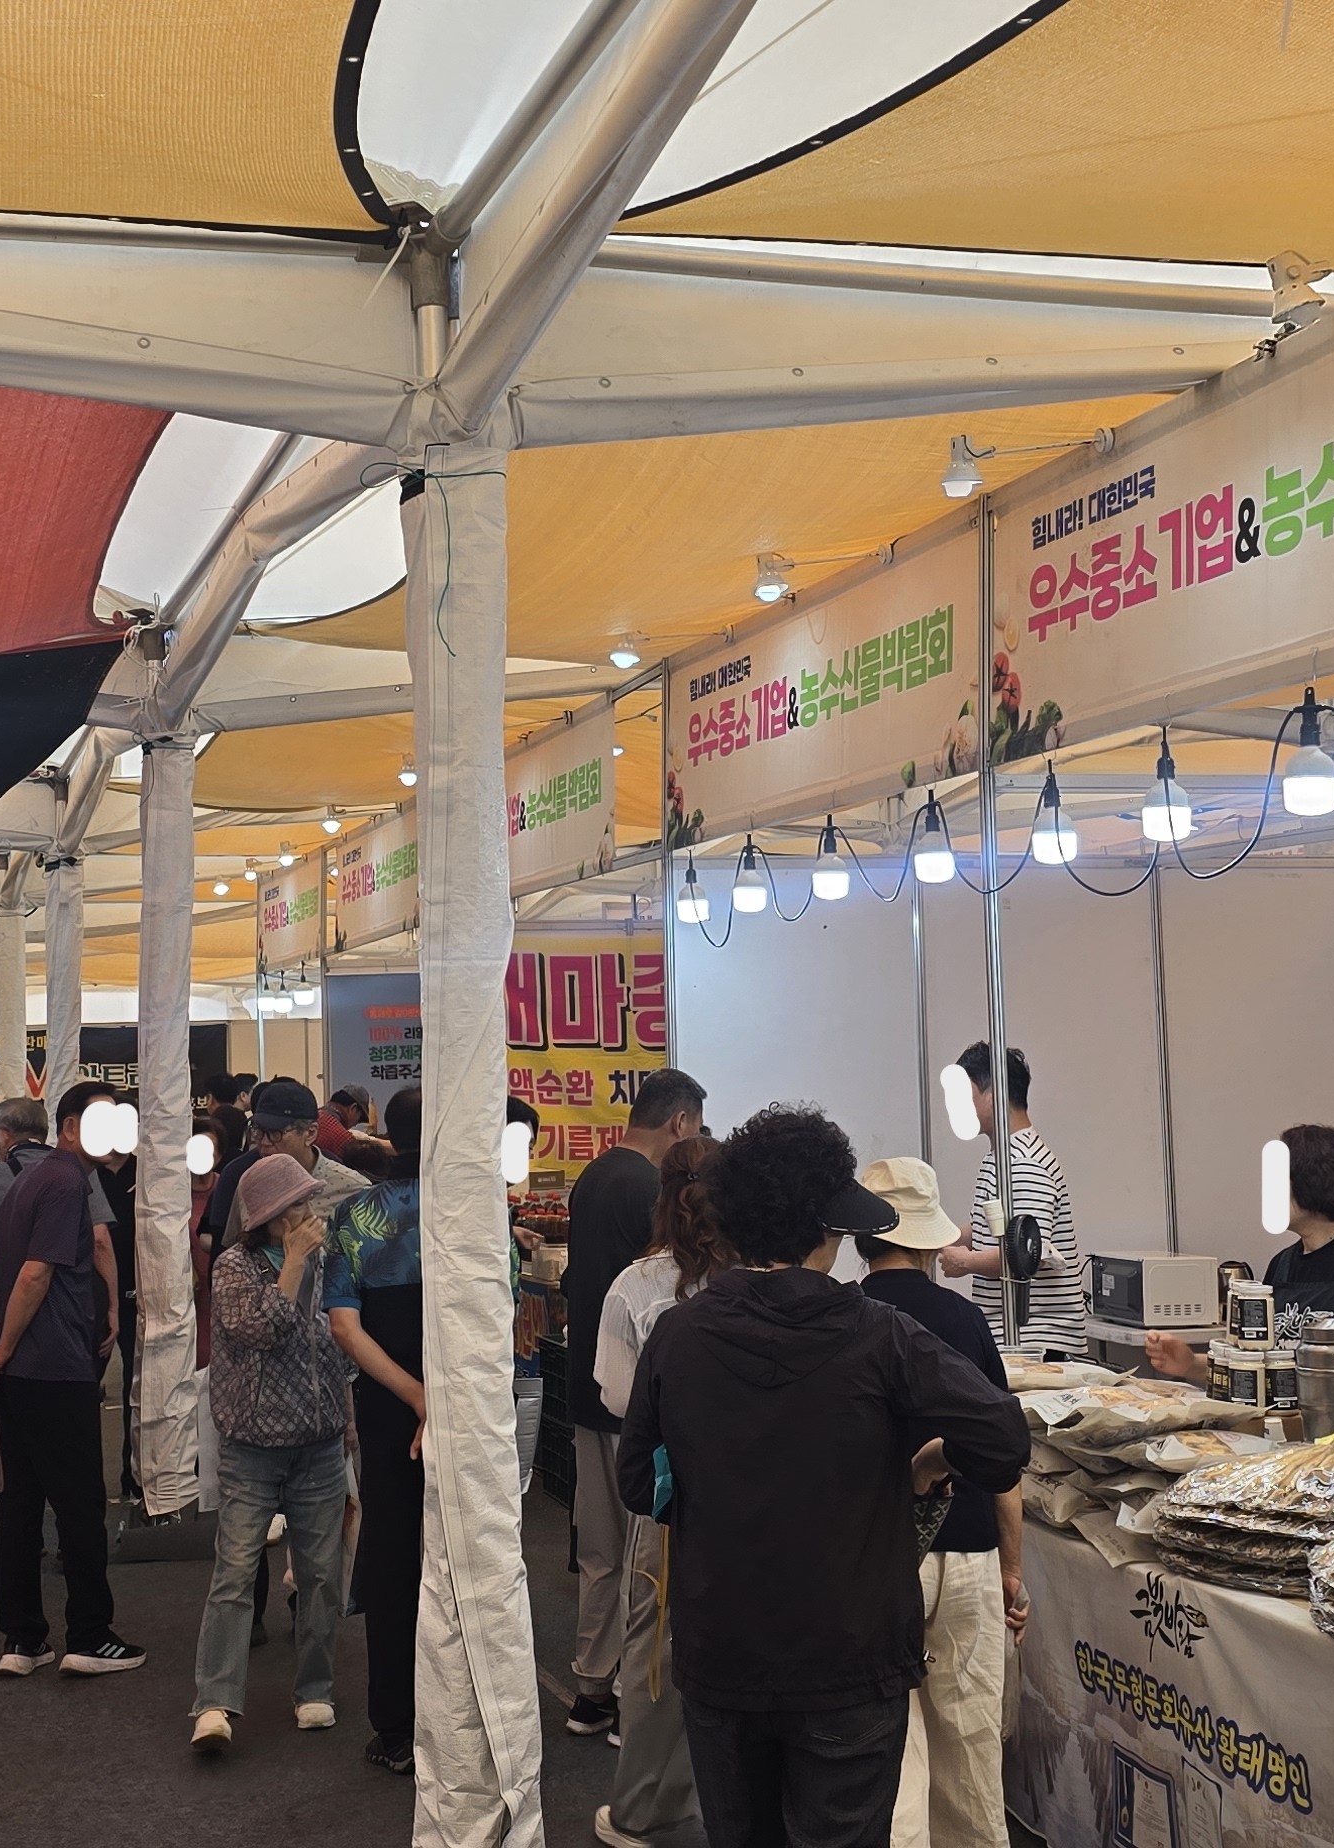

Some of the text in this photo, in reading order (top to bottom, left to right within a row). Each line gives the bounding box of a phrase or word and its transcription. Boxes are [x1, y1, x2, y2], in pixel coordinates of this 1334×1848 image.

[1031, 464, 1156, 551] 힘내라! 대한민국
[369, 1045, 397, 1062] 청정
[529, 1125, 623, 1161] 기름제
[1075, 1641, 1215, 1764] 한국무형문화유산
